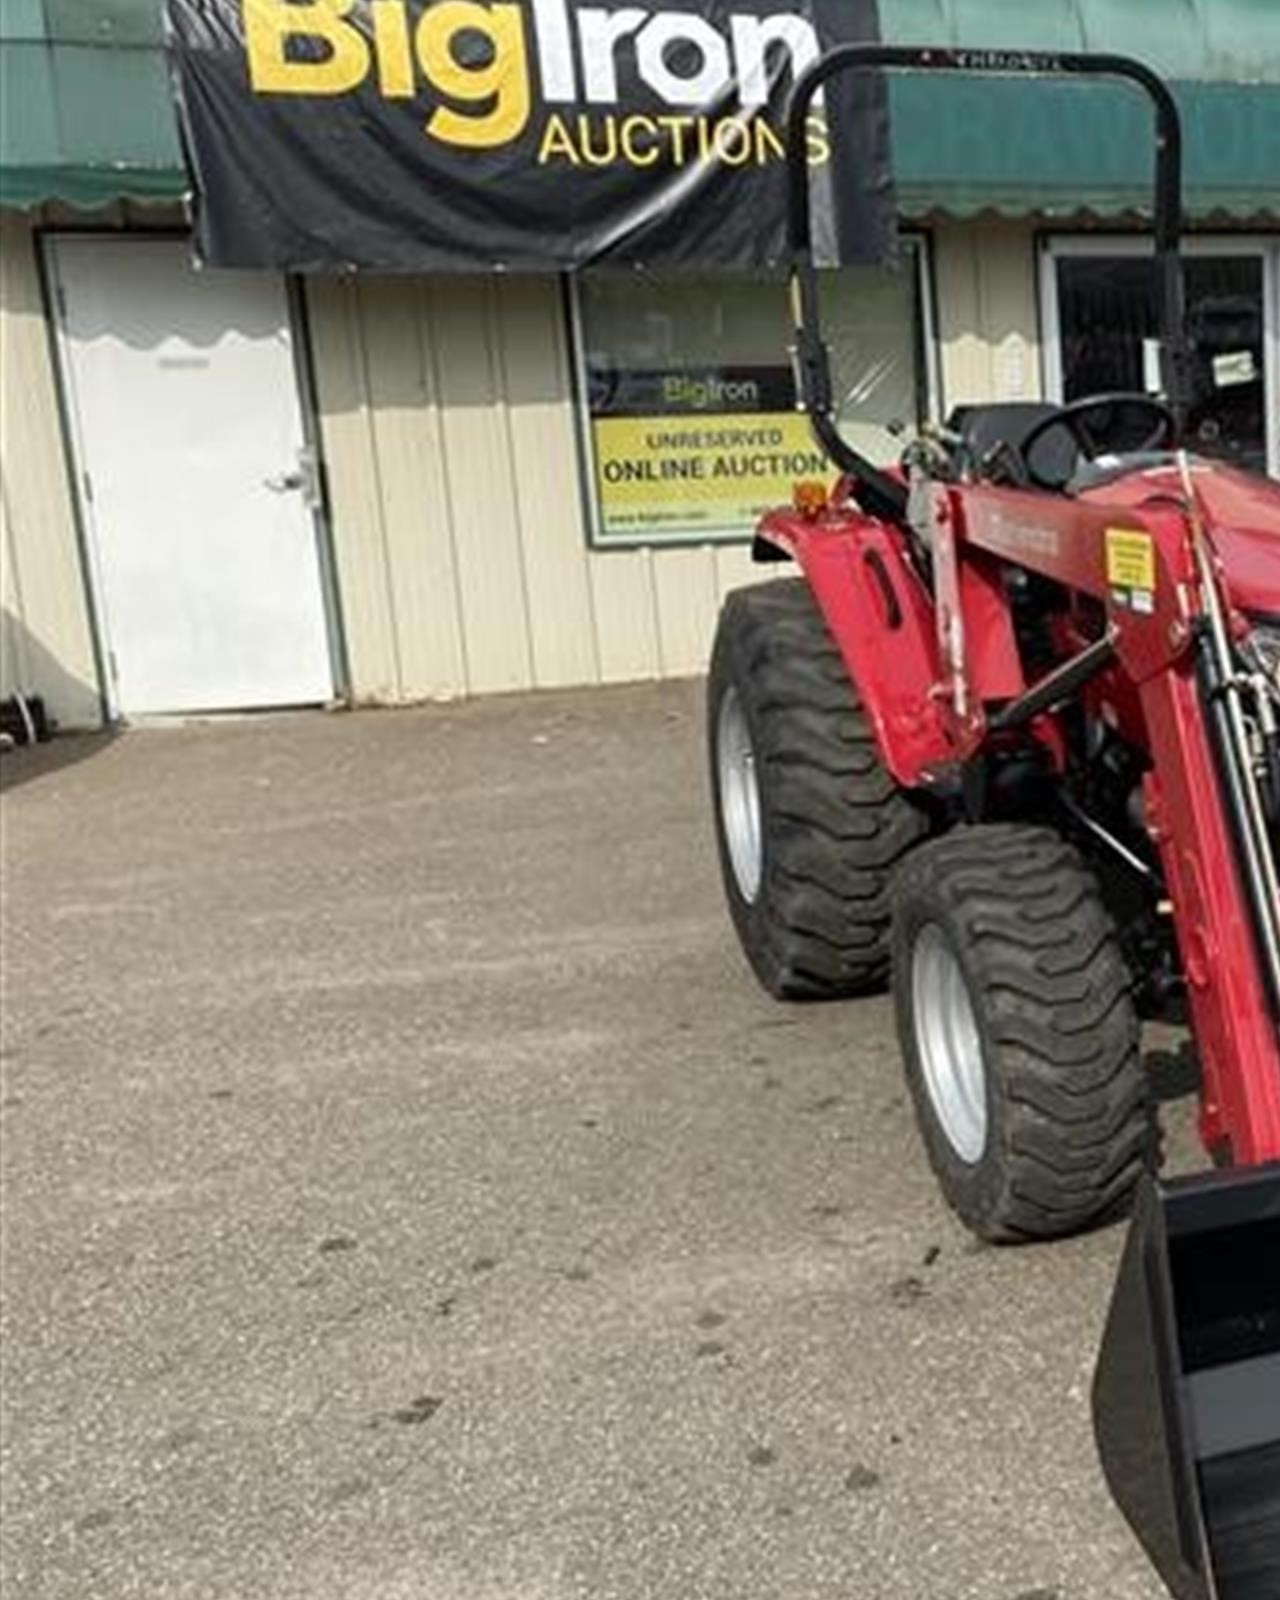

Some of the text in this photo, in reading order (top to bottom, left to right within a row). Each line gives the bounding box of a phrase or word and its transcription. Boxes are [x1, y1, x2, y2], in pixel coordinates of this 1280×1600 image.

[243, 0, 823, 147] BigIron
[538, 115, 831, 166] AUCTIONS
[662, 375, 758, 407] BigIron
[646, 427, 784, 450] UNRESERVED
[603, 450, 829, 485] ONLINE AUCTION
